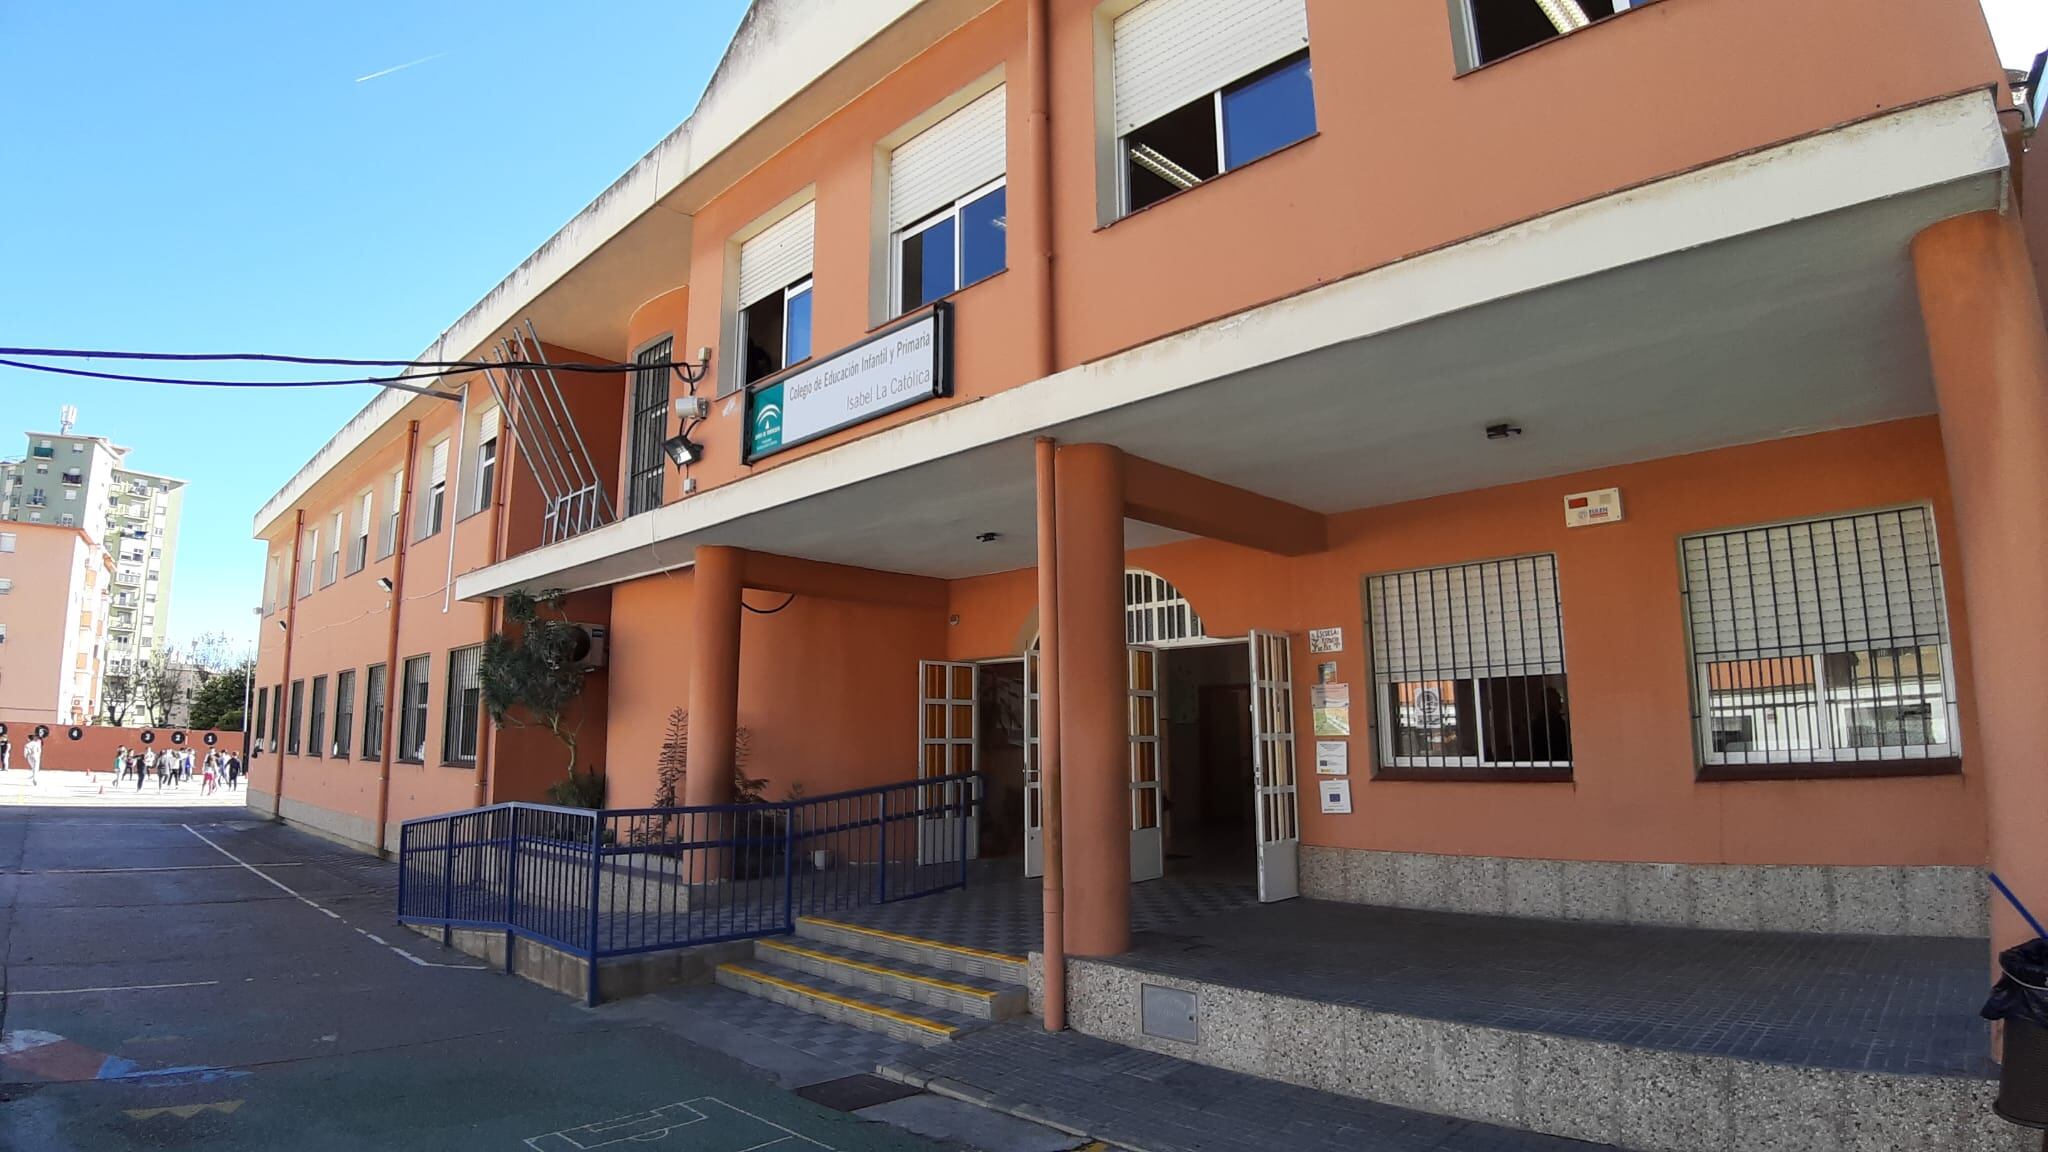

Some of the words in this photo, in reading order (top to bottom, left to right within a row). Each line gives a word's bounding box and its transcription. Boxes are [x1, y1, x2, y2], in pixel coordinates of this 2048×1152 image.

[789, 381, 813, 401] Colegio
[813, 375, 822, 391] de
[824, 362, 859, 387] Educación
[861, 348, 888, 373] Infantil
[889, 350, 895, 365] y
[896, 331, 930, 358] Primaria
[847, 387, 873, 411] Isabel
[876, 384, 887, 401] La
[890, 369, 930, 395] Católica
